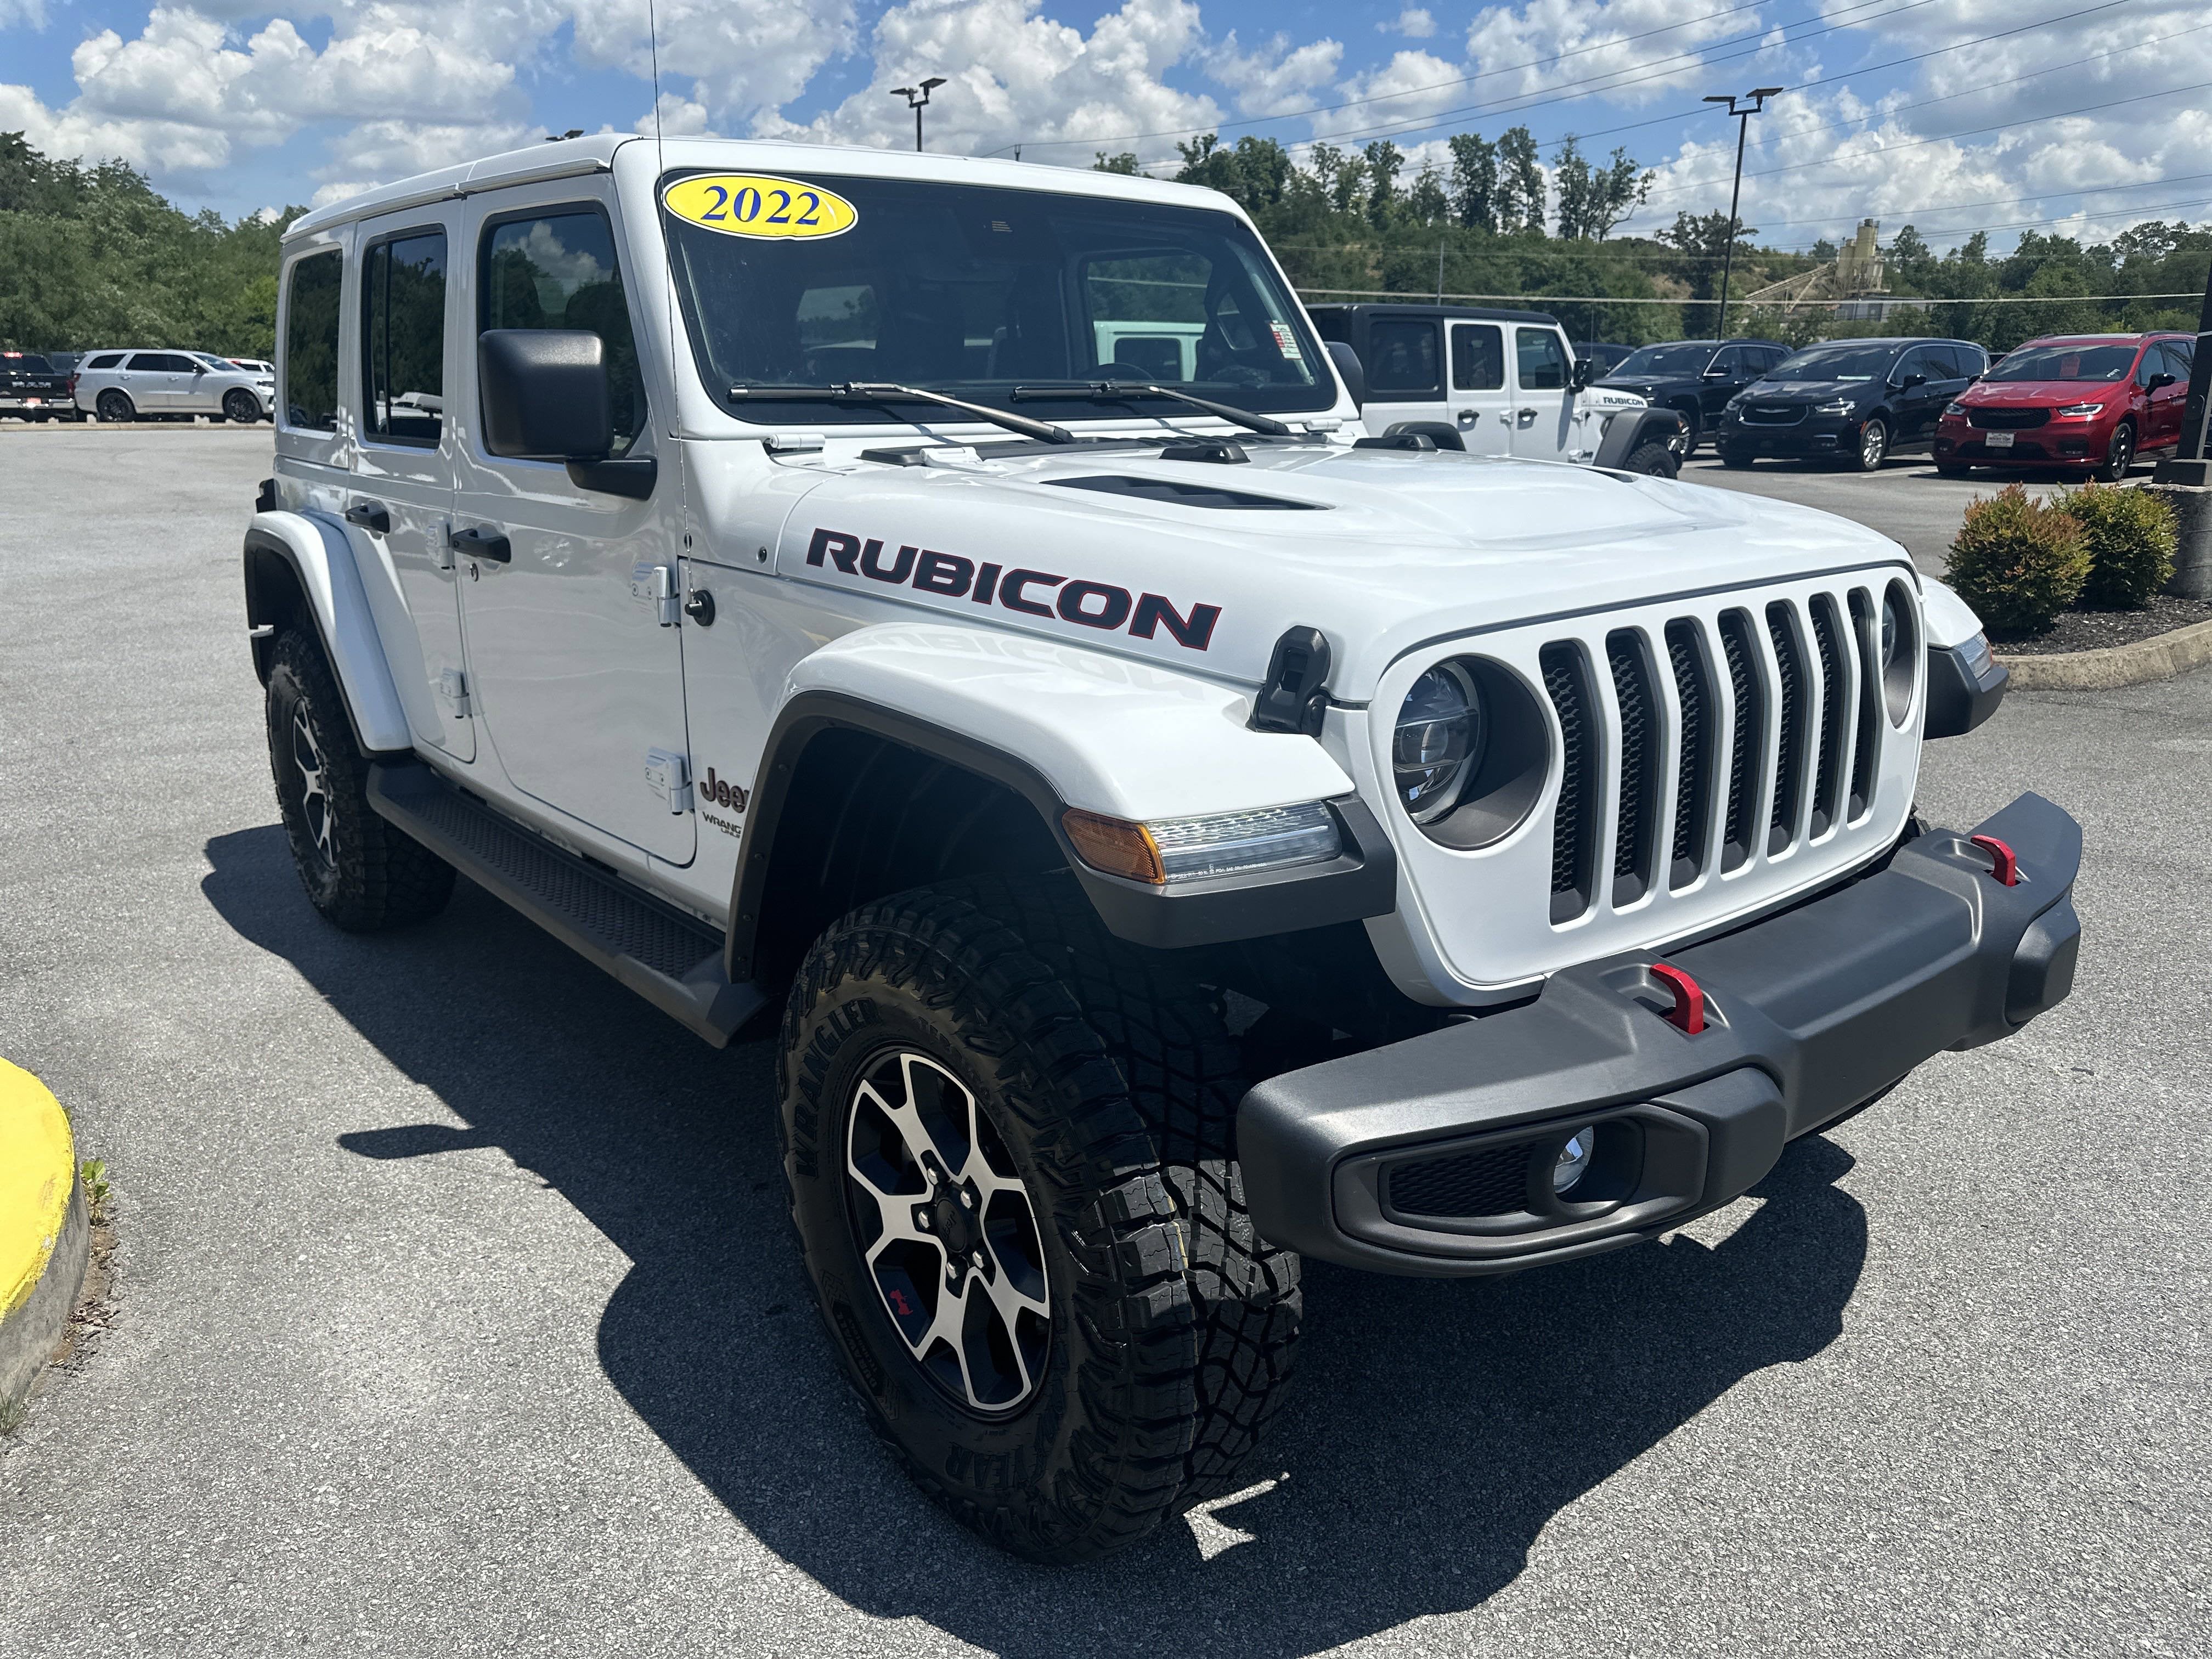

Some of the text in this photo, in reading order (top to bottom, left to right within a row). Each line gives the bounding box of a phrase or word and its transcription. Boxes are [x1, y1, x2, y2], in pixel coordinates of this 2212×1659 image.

[700, 185, 820, 226] 2022
[1603, 397, 1644, 406] RUBICON
[806, 528, 1223, 652] RUBICON
[794, 996, 881, 1178] WRANGLER
